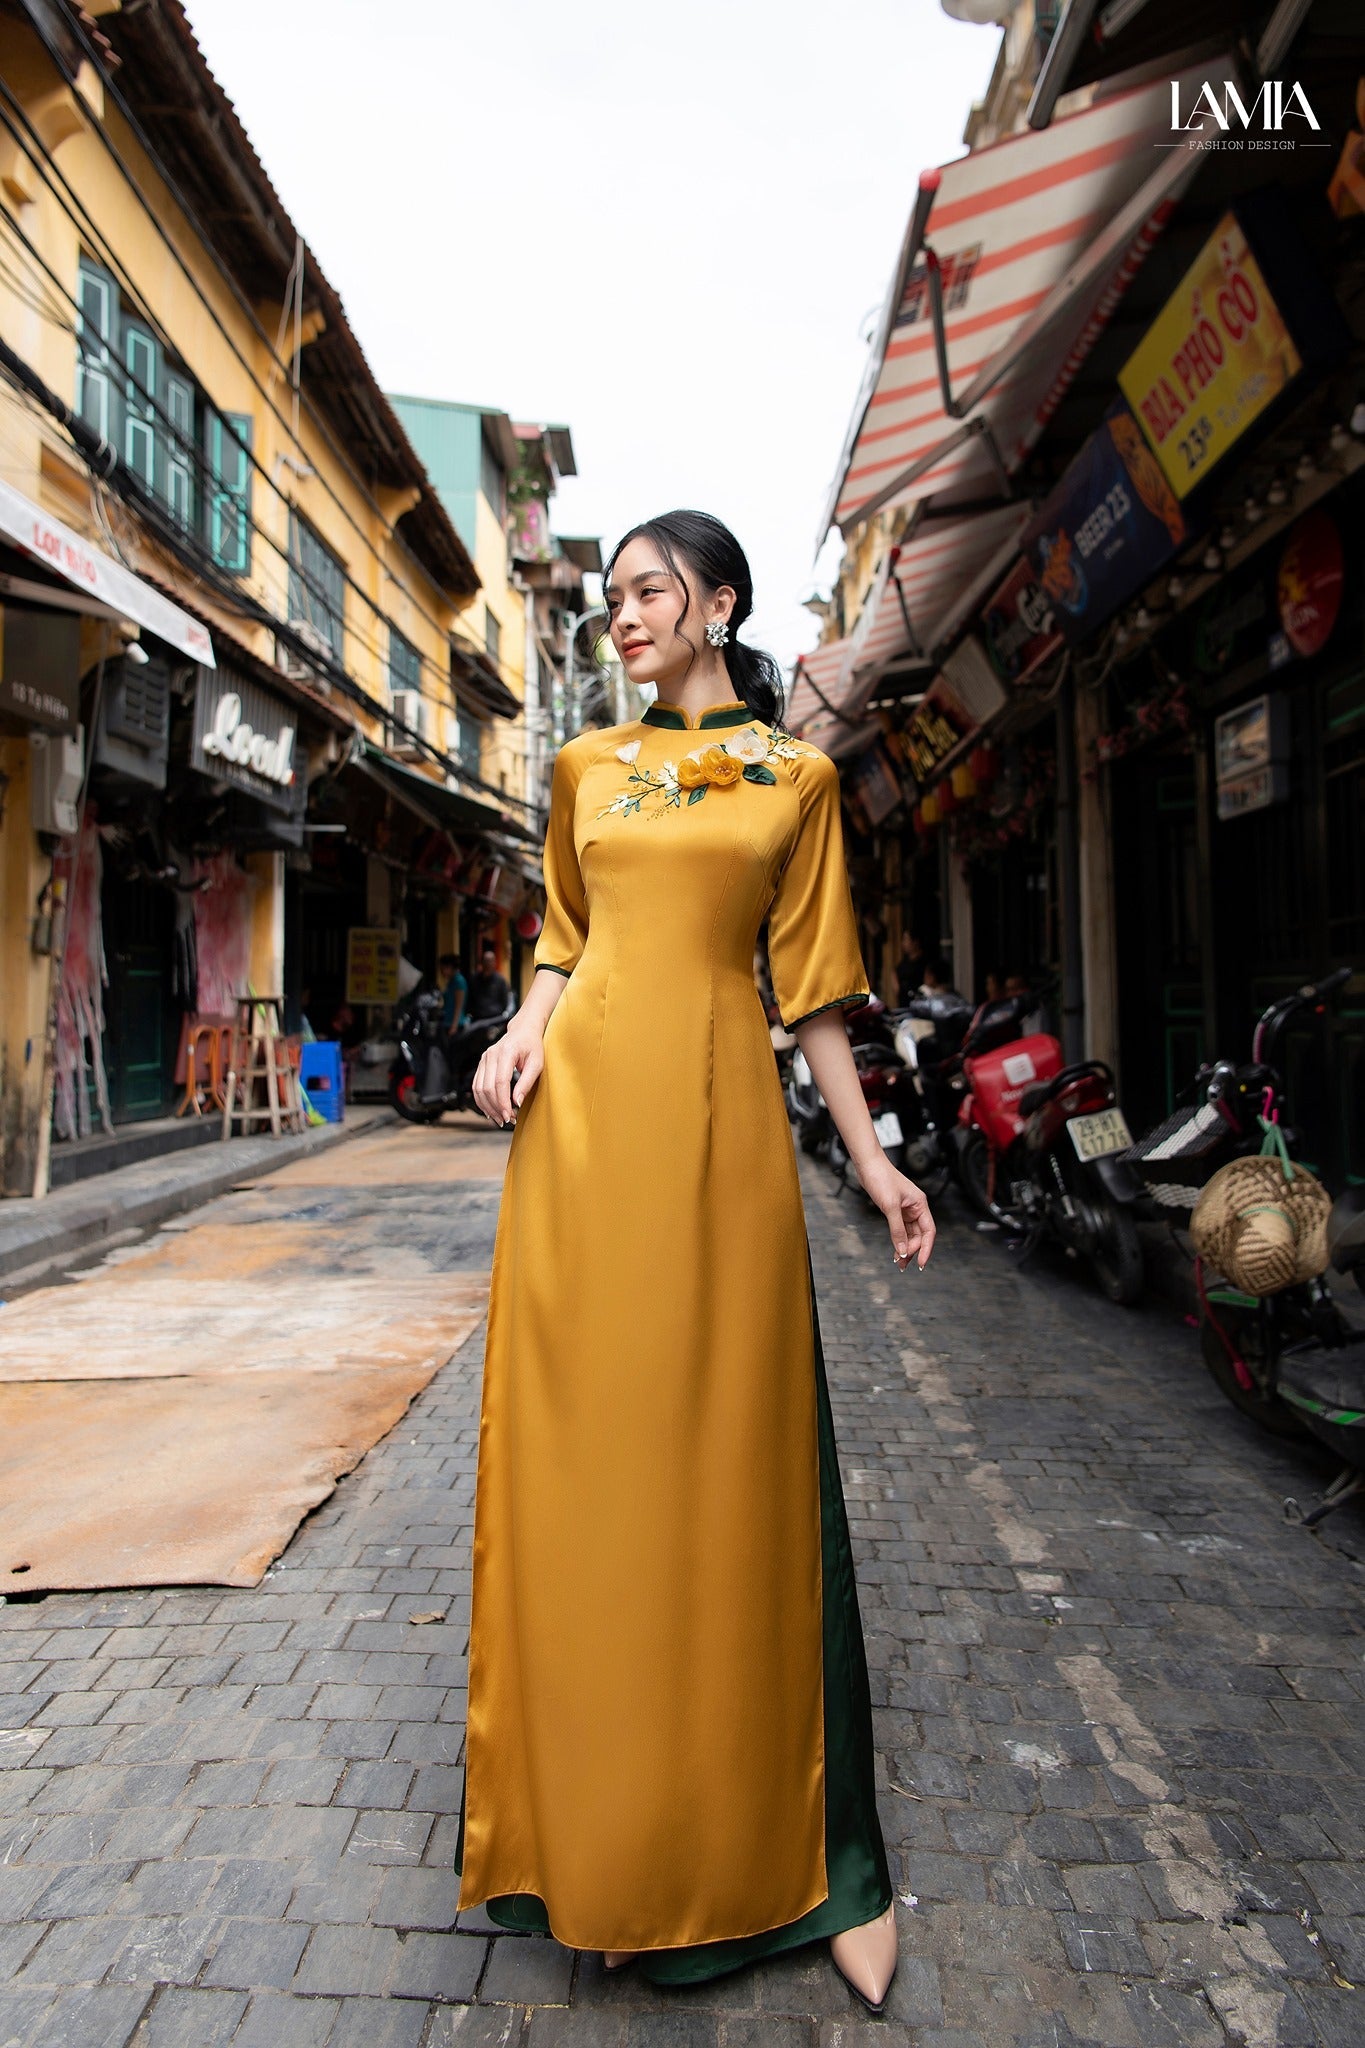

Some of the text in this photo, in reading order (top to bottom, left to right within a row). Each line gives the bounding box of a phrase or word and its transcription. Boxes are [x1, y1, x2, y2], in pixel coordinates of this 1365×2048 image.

[1140, 376, 1186, 443] BIA
[1172, 286, 1224, 401] PHỐ
[1073, 503, 1115, 559] BEER
[1105, 482, 1132, 522] 23
